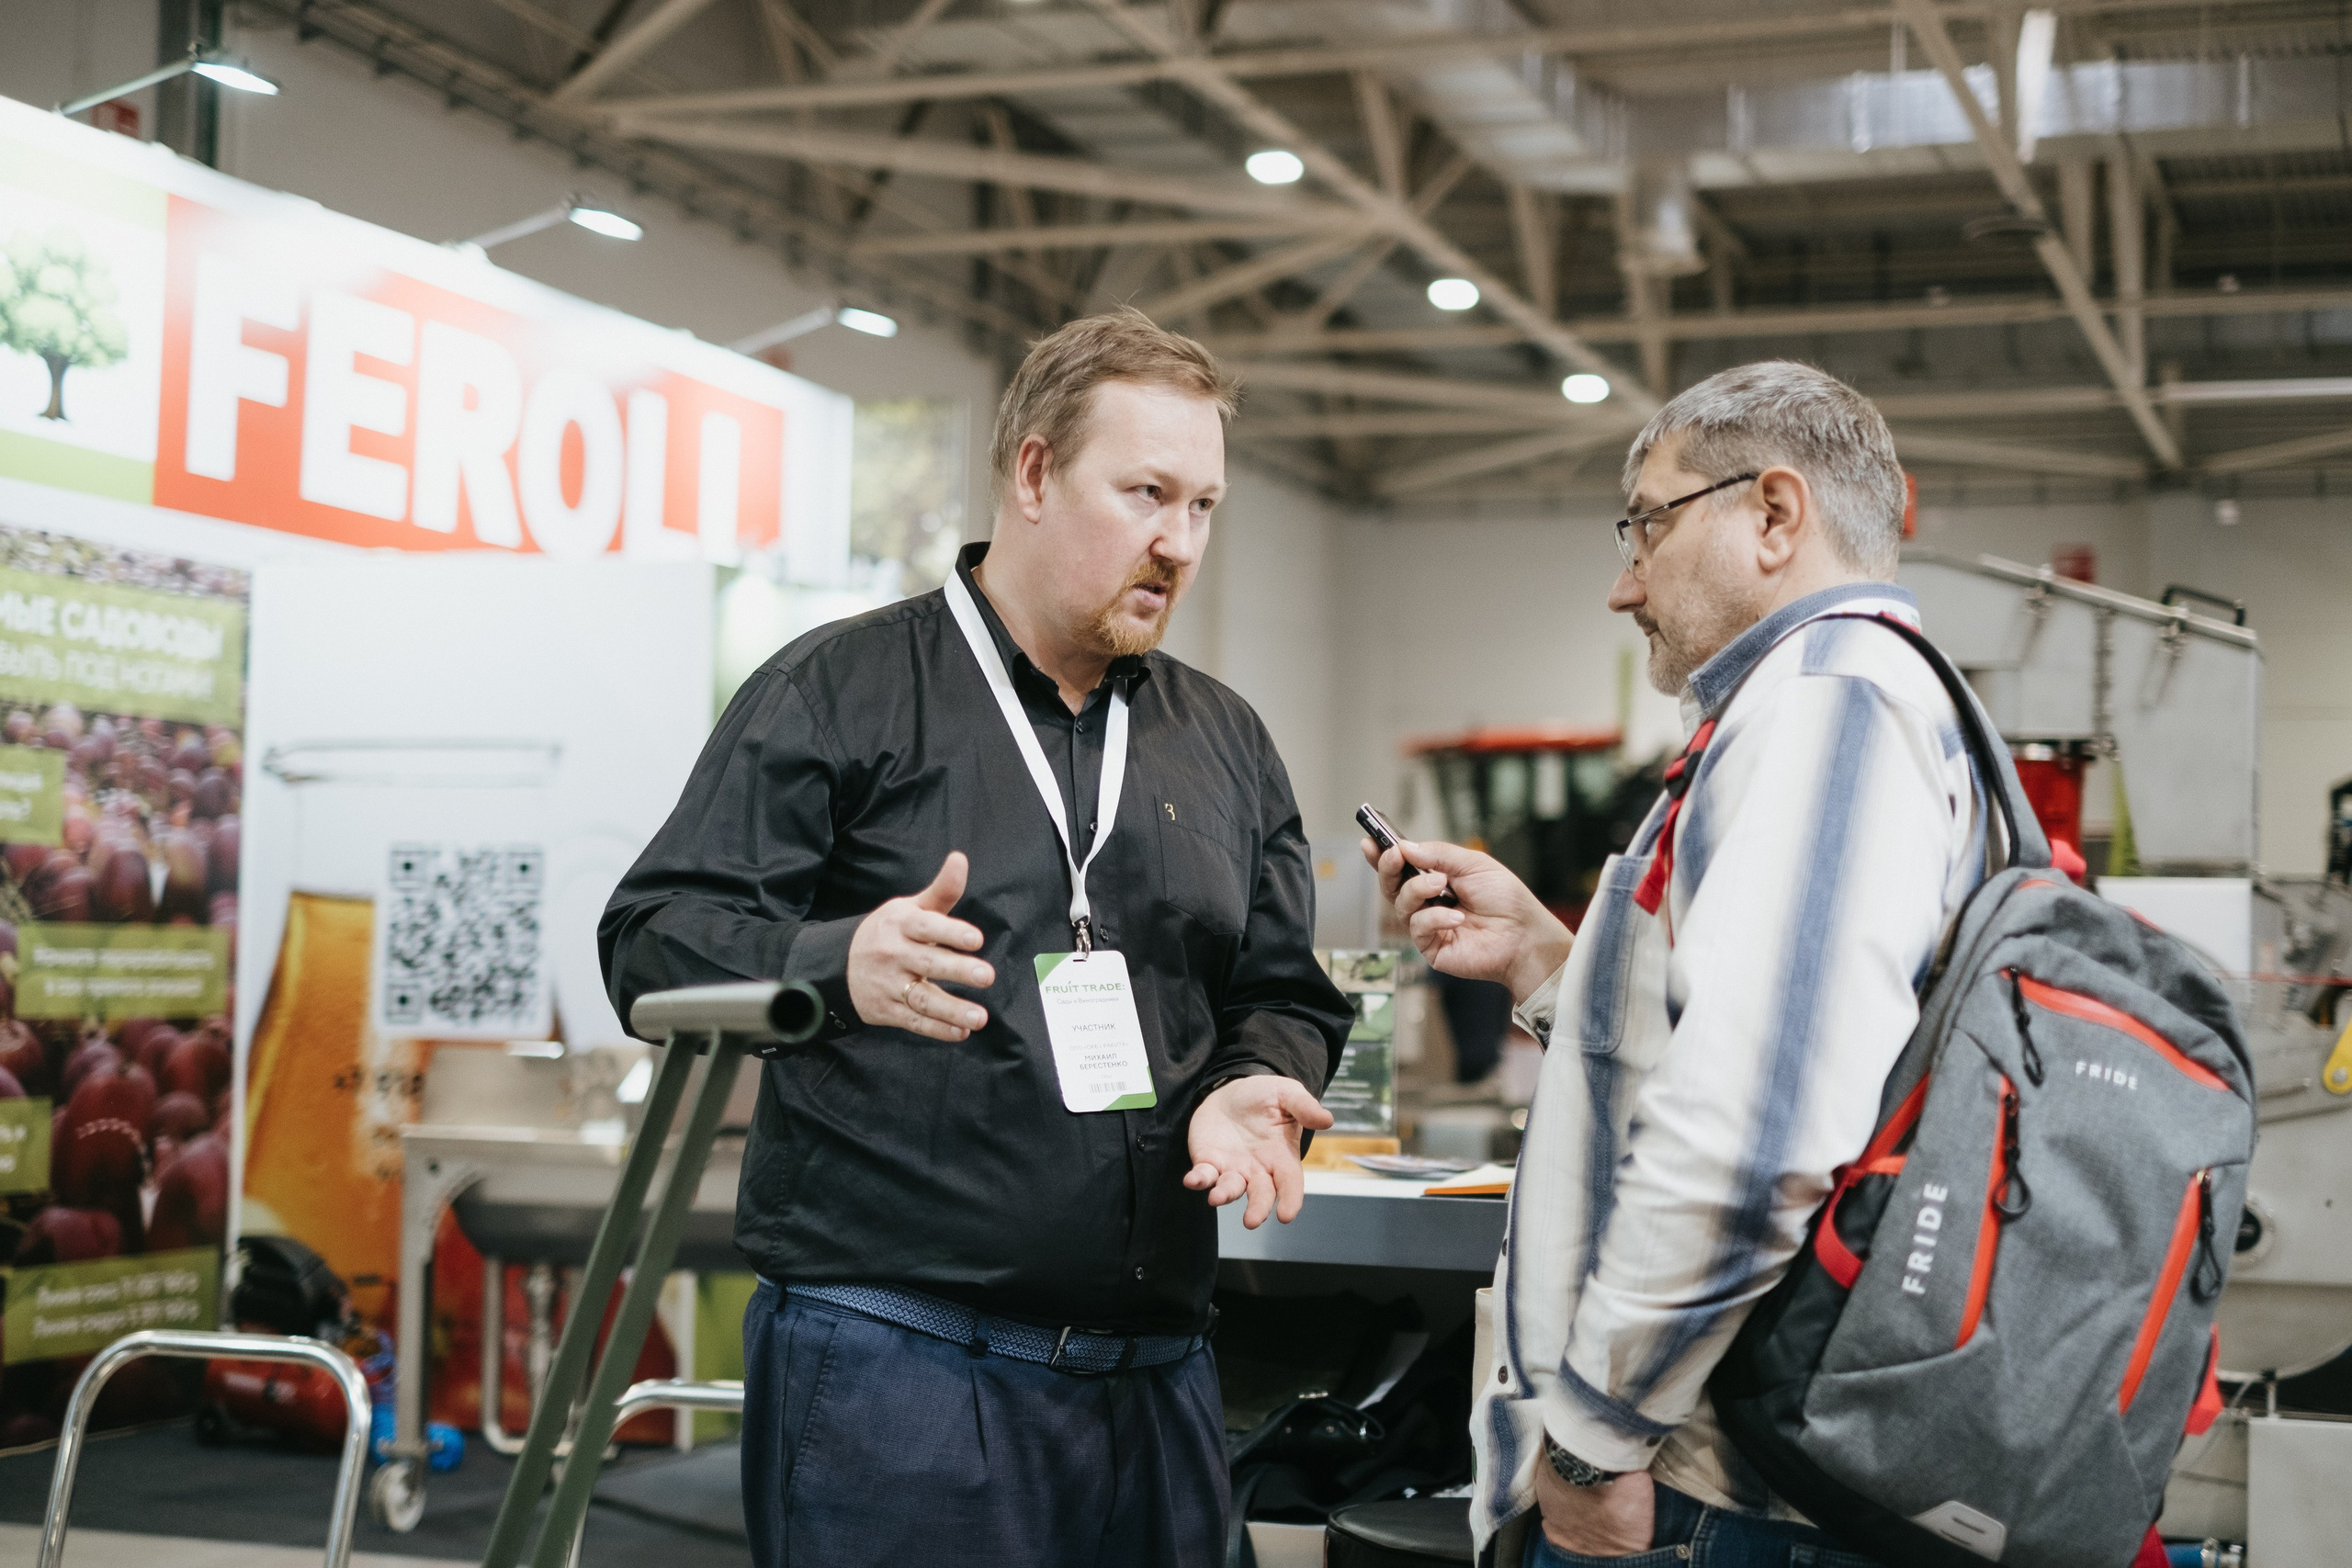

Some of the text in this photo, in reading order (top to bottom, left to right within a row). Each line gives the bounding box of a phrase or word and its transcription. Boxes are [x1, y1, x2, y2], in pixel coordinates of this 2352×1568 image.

[185, 252, 741, 563] FEROLI
[1046, 982, 1080, 993] FRUIT
[1071, 1023, 1116, 1032] УЧАСТНИК
[1084, 1053, 1117, 1062] МИХАИЛ
[1080, 1061, 1128, 1070] БЕРЕСТЕНКО
[2075, 1060, 2139, 1090] FRIDE
[1901, 1182, 1949, 1295] FRIDE
